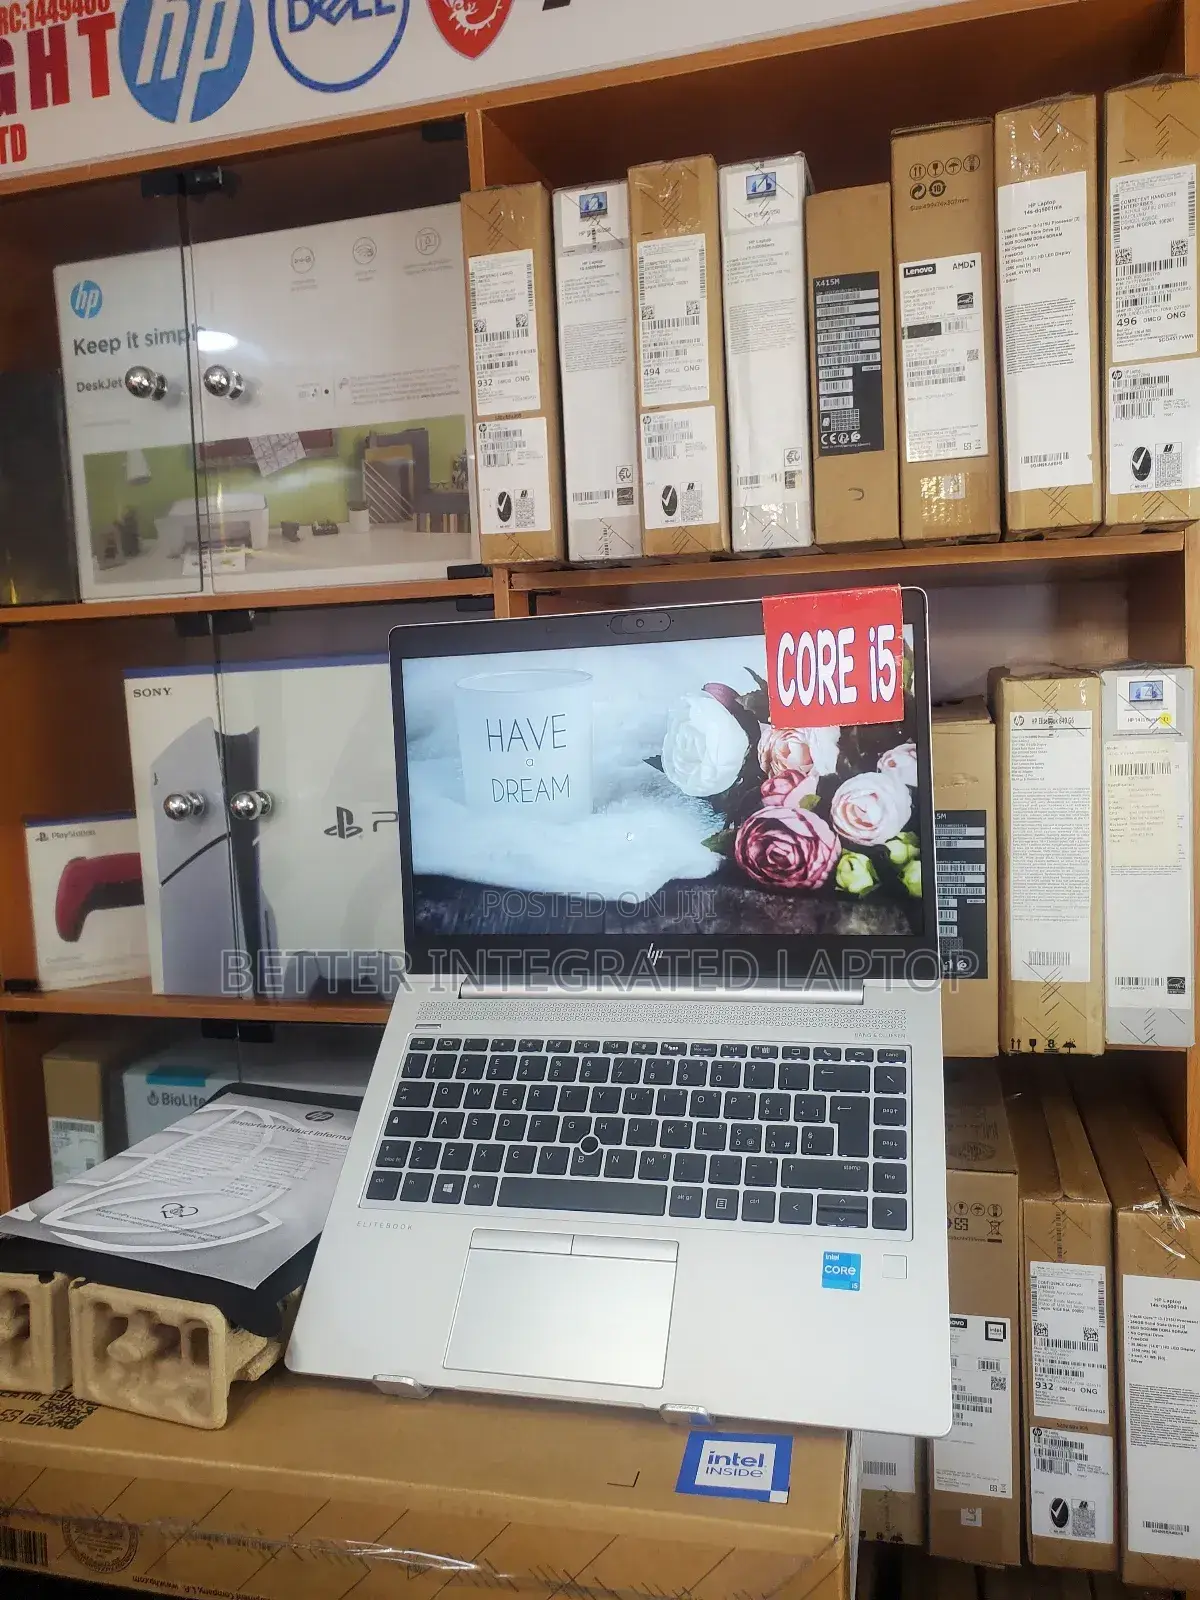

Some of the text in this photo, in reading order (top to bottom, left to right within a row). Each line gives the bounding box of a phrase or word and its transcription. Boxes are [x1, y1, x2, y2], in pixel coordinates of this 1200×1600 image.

[905, 266, 934, 276] Lenovo
[952, 262, 969, 270] AMD
[816, 278, 840, 287] X415M
[1116, 311, 1186, 326] 496 ONG
[73, 321, 207, 356] Keep it simpl
[644, 364, 700, 376] 494 ONG
[76, 376, 123, 393] DeskJet
[478, 375, 530, 388] 932 ONG
[776, 623, 897, 708] CORE i5
[134, 687, 172, 698] SONY
[485, 712, 568, 754] HAVE
[525, 756, 534, 768] a
[490, 774, 571, 804] DREAM
[52, 829, 96, 840] PlayStation
[230, 1120, 276, 1130] Important
[276, 1124, 314, 1136] Product
[356, 1220, 413, 1230] ELITEBOOK
[1035, 1381, 1054, 1391] 932
[708, 1450, 765, 1468] intel
